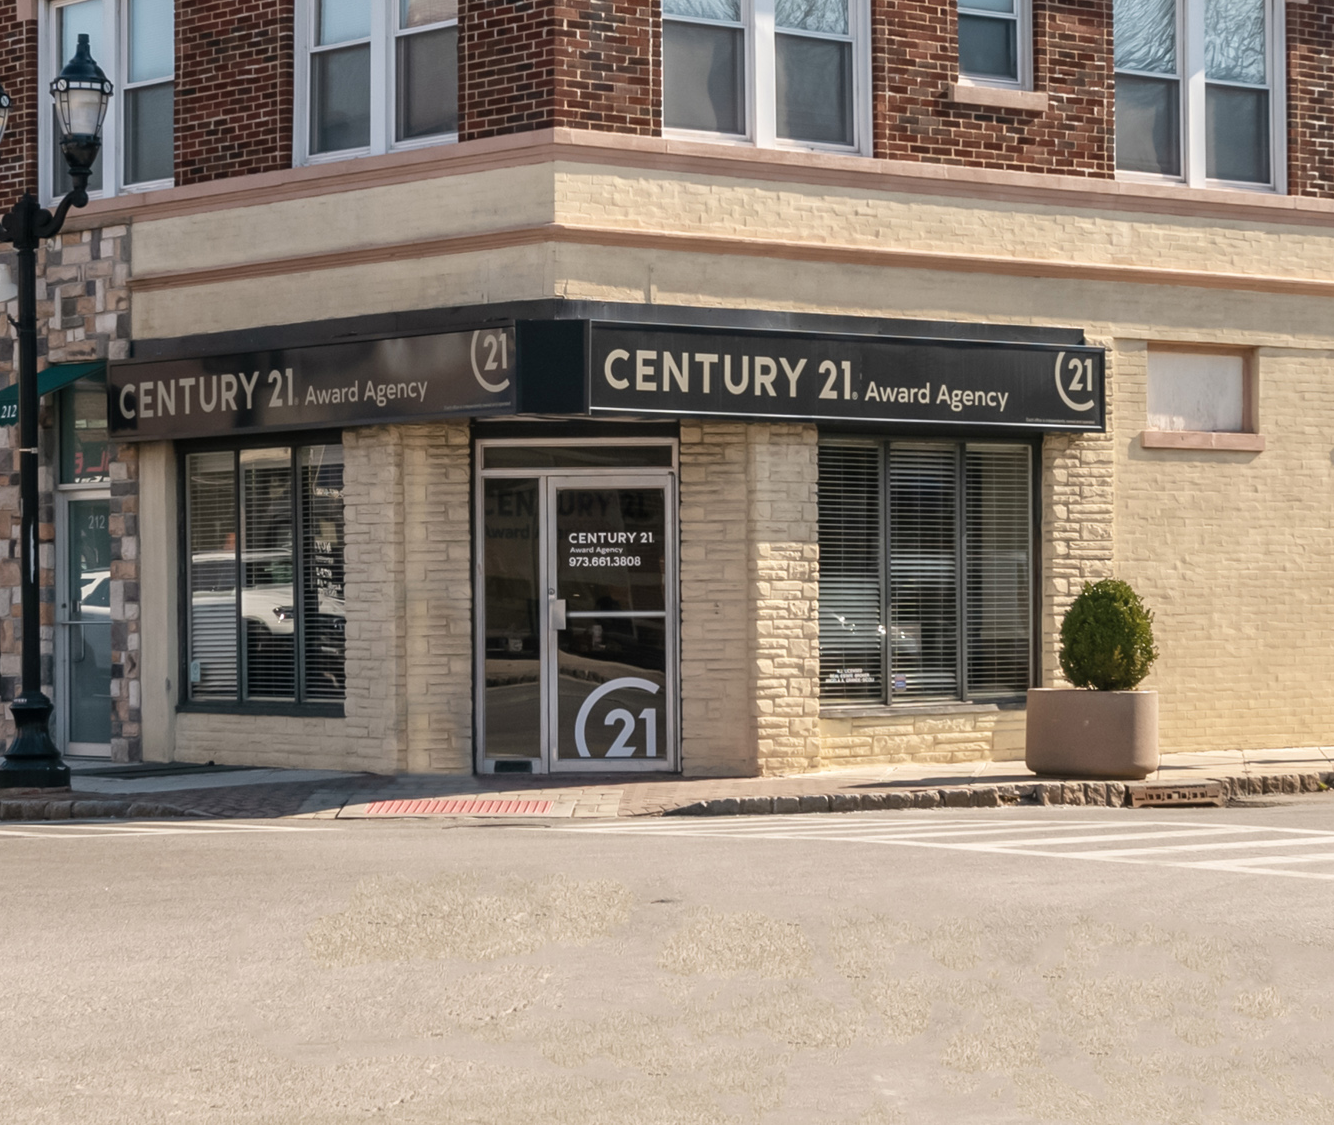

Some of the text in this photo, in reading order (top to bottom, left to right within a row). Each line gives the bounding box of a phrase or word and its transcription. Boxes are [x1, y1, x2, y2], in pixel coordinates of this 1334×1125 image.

[604, 349, 808, 398] CENTURY
[865, 381, 930, 404] Award
[936, 384, 1009, 412] Agency
[119, 371, 260, 420] CENTURY
[305, 380, 359, 406] Award
[364, 380, 428, 407] Agency
[0, 404, 18, 419] 212
[88, 514, 106, 529] 212
[569, 532, 637, 544] CENTURY
[569, 546, 623, 555] Award Agency
[569, 556, 641, 567] 973.661.3808
[603, 707, 657, 758] 21
